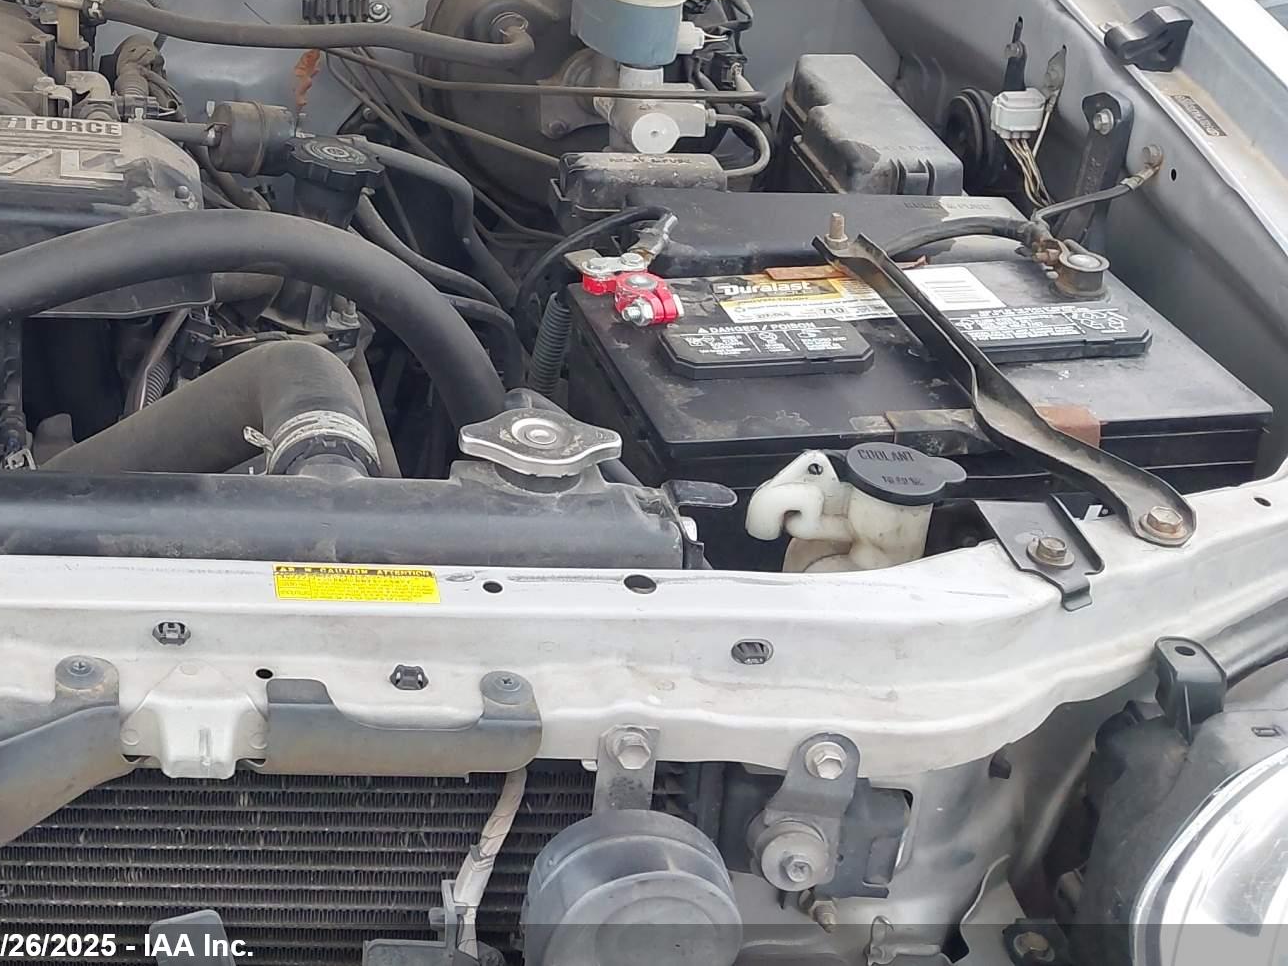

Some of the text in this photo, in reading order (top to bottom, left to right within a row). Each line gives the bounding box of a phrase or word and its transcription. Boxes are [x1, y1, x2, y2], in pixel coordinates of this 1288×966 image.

[29, 118, 121, 135] FORCE
[717, 281, 812, 296] Duralast
[709, 325, 759, 333] DANGER
[770, 322, 816, 330] POISON
[857, 449, 915, 462] COOLANT
